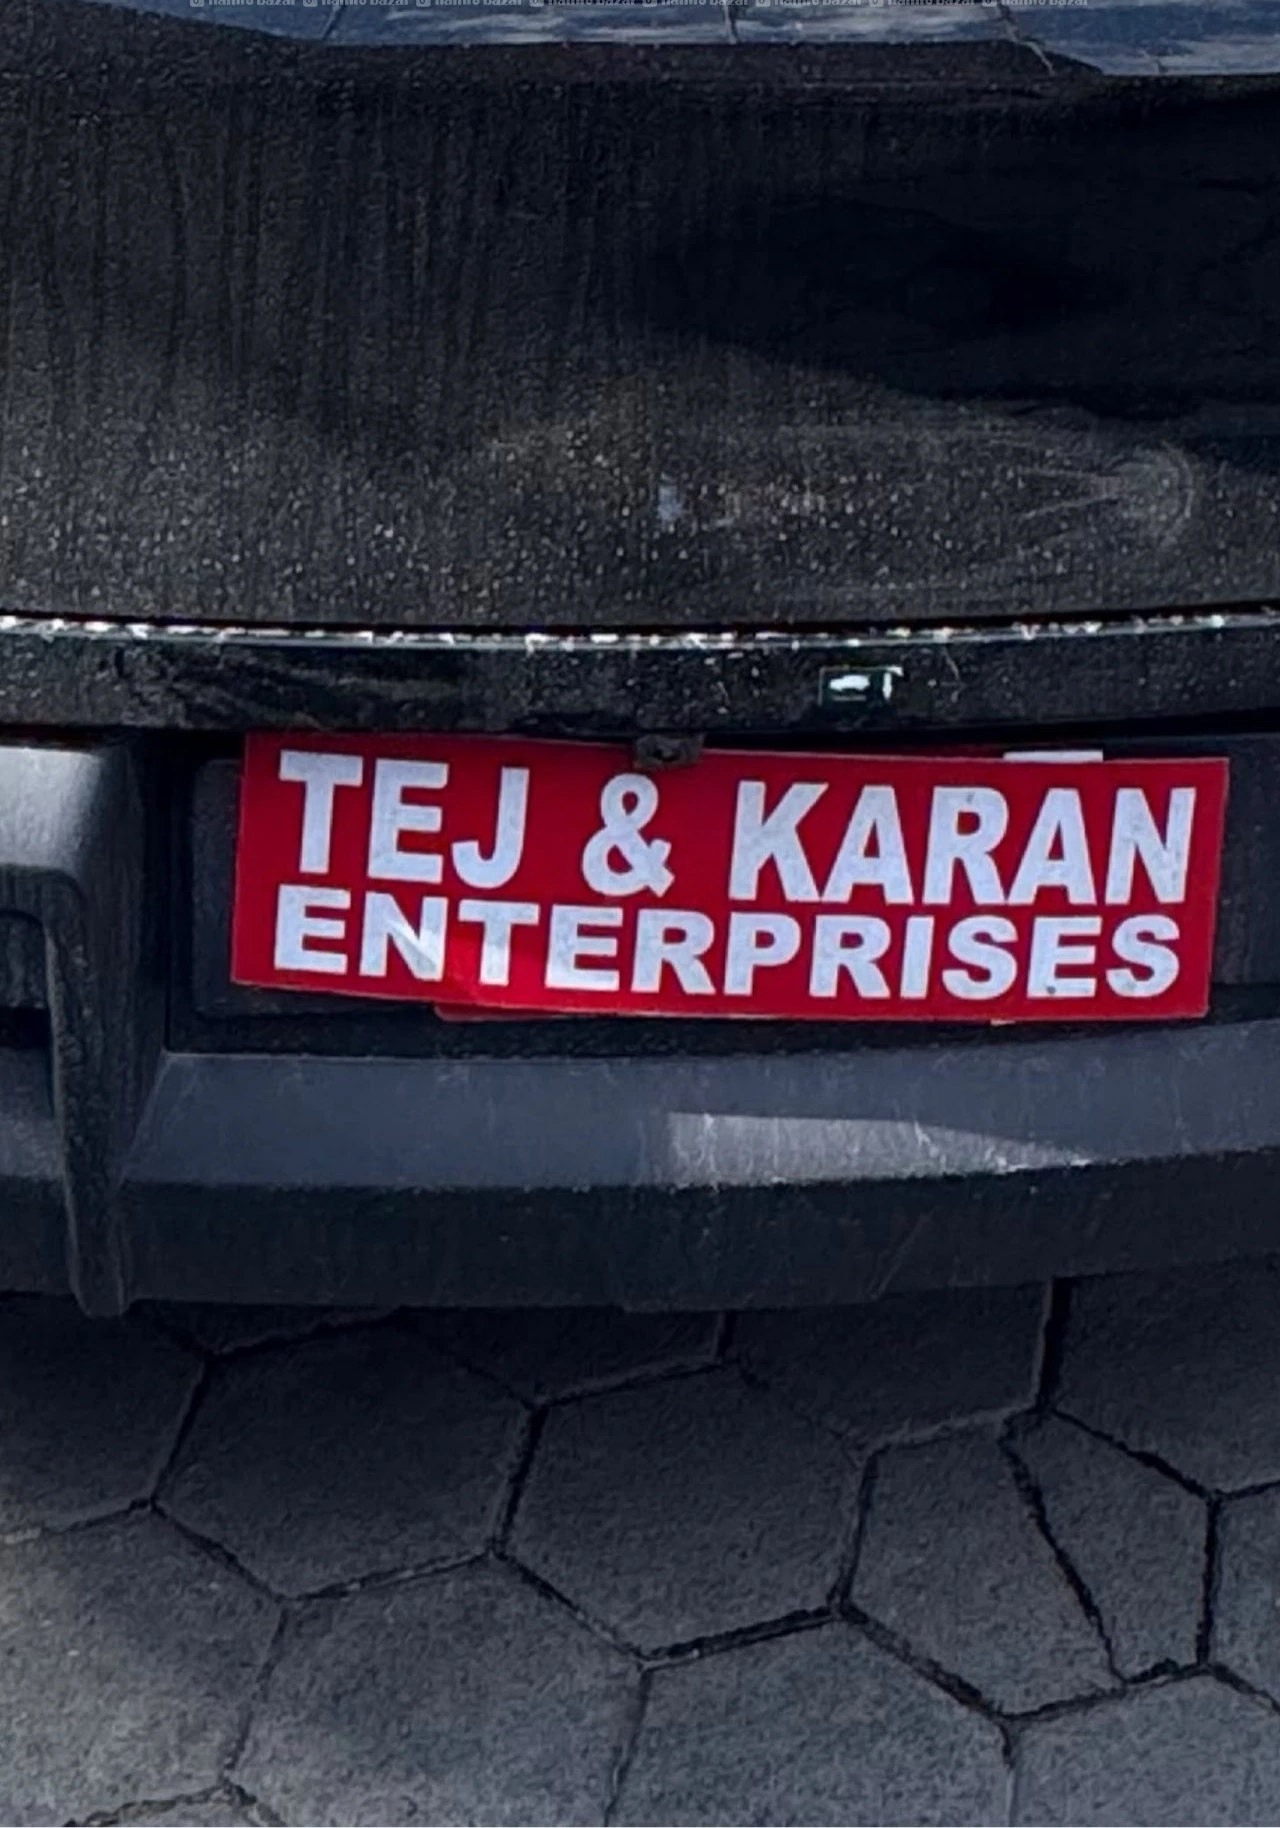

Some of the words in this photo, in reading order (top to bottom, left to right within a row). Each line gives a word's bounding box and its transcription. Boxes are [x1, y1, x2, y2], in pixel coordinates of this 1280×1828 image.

[278, 749, 531, 891] TEJ
[581, 773, 676, 898] &
[730, 780, 1197, 906] KARAN
[273, 886, 1182, 1000] ENTERPRISES
